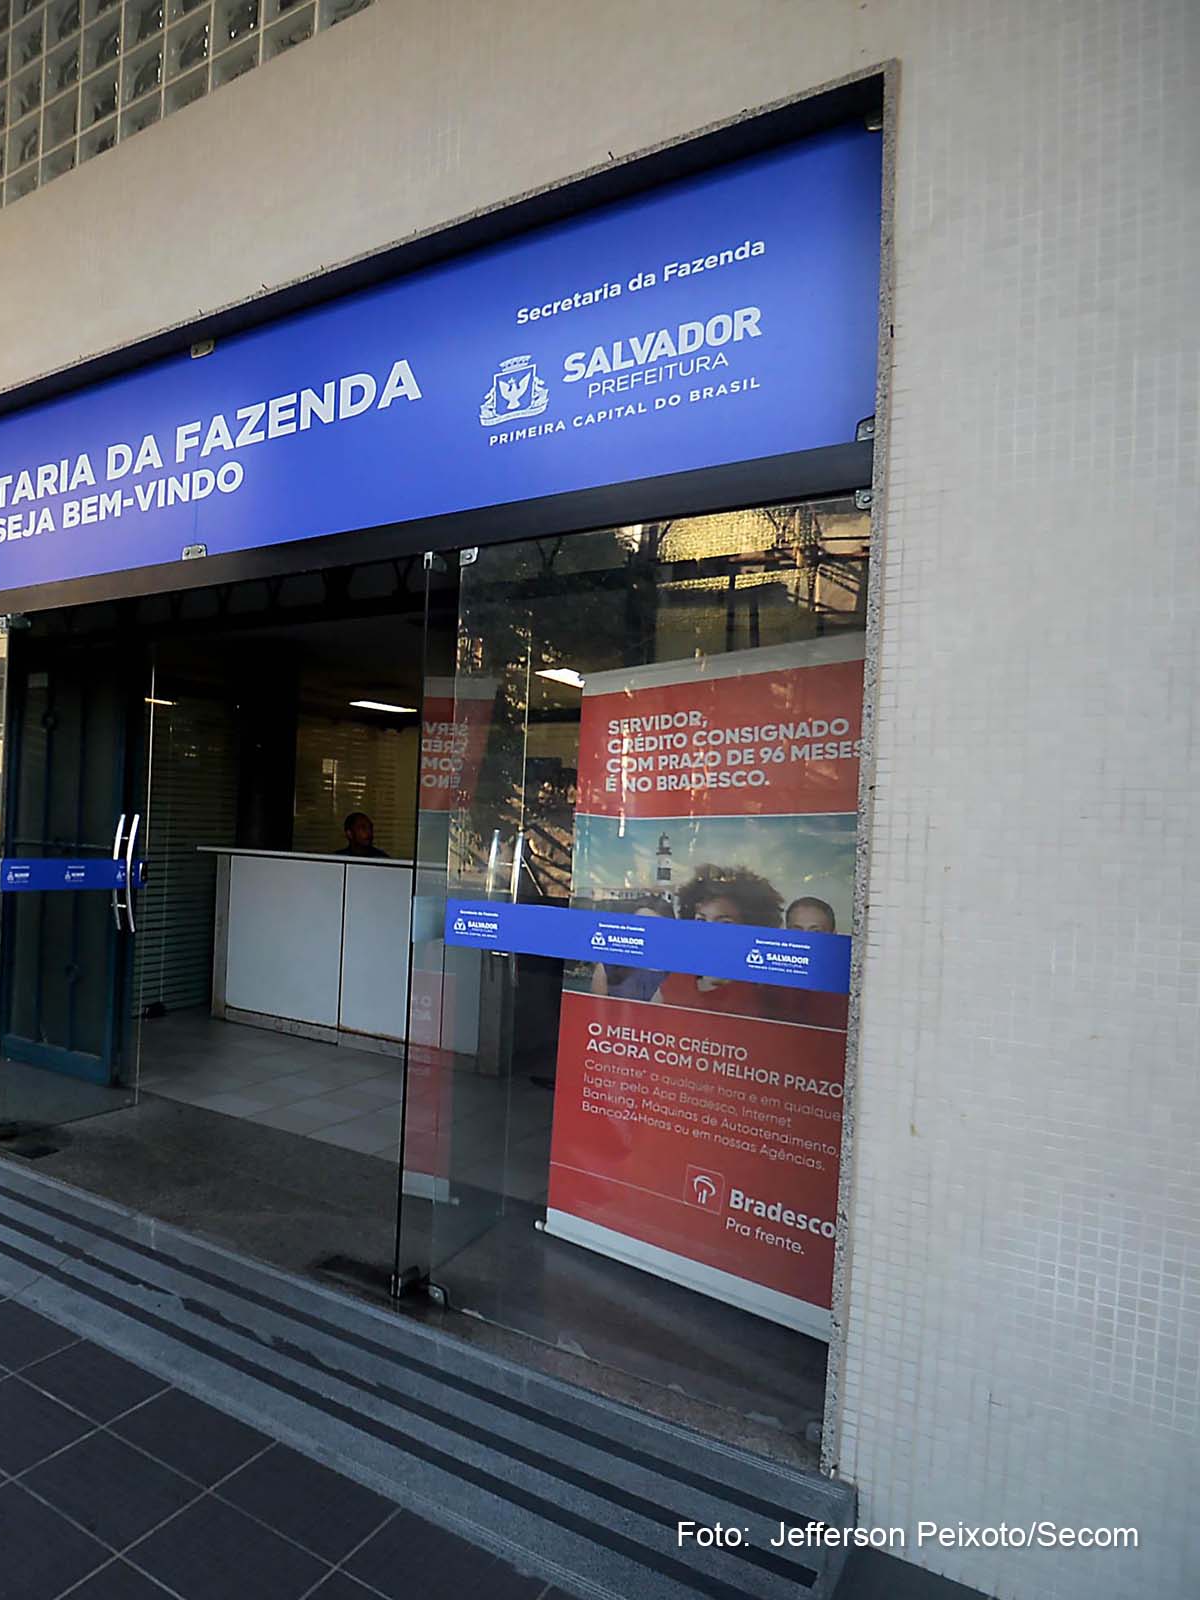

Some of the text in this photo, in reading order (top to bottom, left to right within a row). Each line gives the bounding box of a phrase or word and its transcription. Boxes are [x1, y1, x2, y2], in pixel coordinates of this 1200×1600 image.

[517, 240, 766, 325] Secretaria da Fazenda
[562, 306, 762, 383] SALVADOR
[587, 351, 729, 399] PREFEITURA
[105, 434, 163, 483] DA
[175, 359, 422, 464] FAZENDA
[489, 376, 761, 447] PRIMEIRA CAPITAL DO BRASIL
[62, 461, 244, 529] BEM-VINDO
[607, 711, 709, 735] SERVIDOR,
[607, 717, 850, 754] CRÉDITO CONSIGNADO
[605, 769, 771, 793] É NO BRADESCO.
[606, 756, 654, 774] COM
[658, 750, 722, 771] PRAZO
[727, 748, 755, 766] DE
[759, 747, 786, 764] 96
[766, 952, 809, 965] SALVADOR
[587, 1022, 748, 1061] O MELHOR CRÉDITO
[586, 1039, 843, 1098] AGORA COM O MELHOR PRAZO
[583, 1072, 616, 1088] lugar
[620, 1082, 649, 1097] pelo
[742, 1106, 792, 1128] Internet
[701, 1114, 718, 1126] de
[760, 1095, 780, 1107] em
[581, 1100, 672, 1130] Banco24Horas
[674, 1124, 689, 1135] ou
[692, 1129, 711, 1140] em
[714, 1132, 757, 1153] nossas
[726, 1217, 805, 1255] Pra frente.
[728, 1188, 837, 1239] Bradesco
